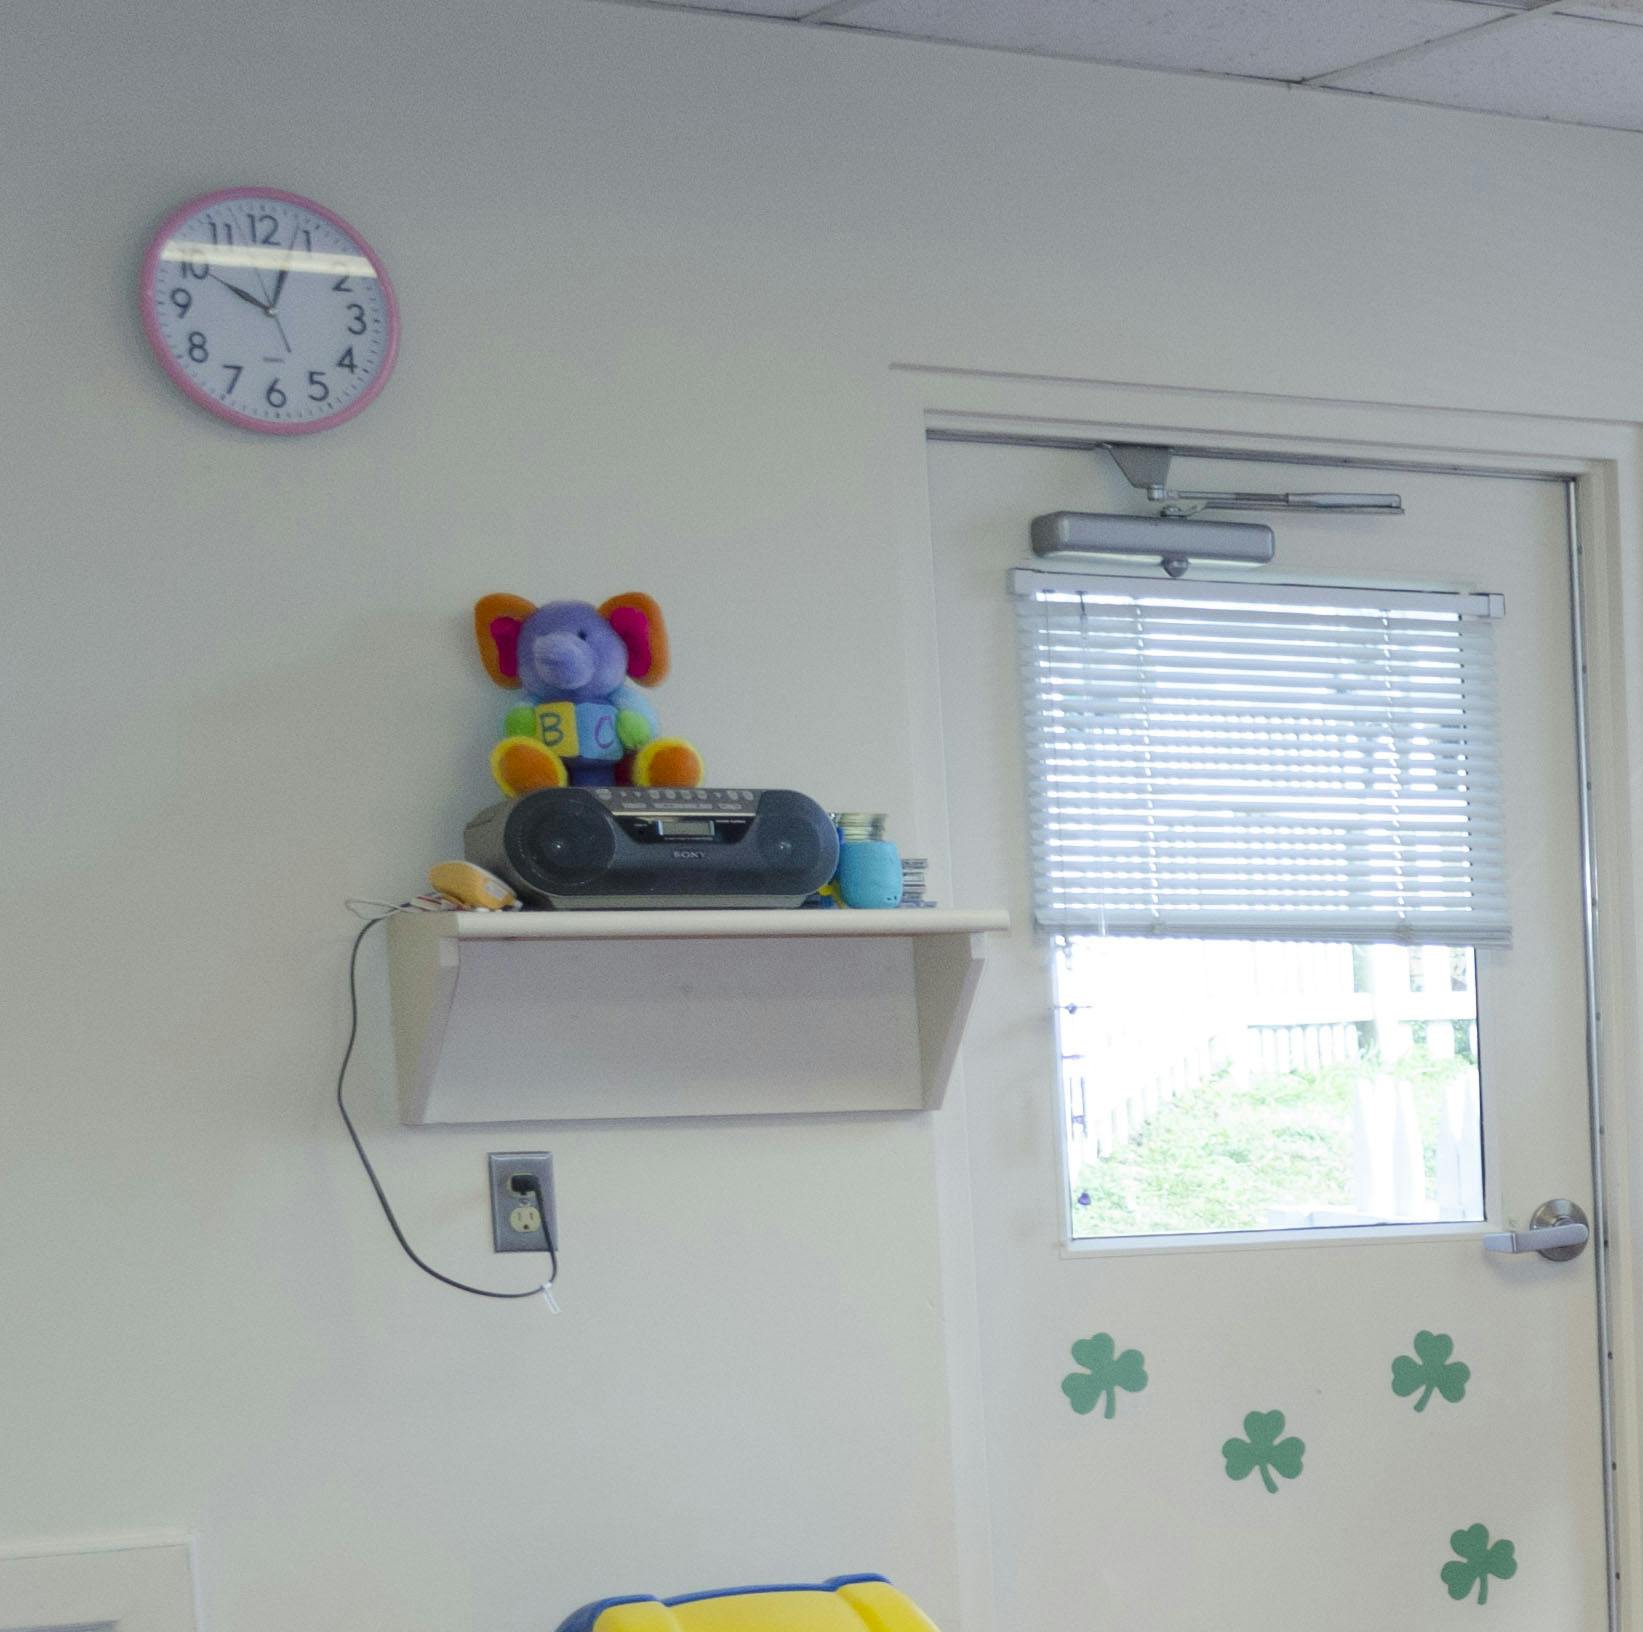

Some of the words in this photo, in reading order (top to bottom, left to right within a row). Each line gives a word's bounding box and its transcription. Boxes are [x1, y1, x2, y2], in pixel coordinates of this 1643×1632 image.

[207, 221, 233, 248] 11
[247, 213, 281, 246] 12
[302, 229, 312, 253] 1
[170, 287, 193, 319] 9
[346, 303, 368, 336] 3
[188, 331, 209, 364] 8
[336, 346, 358, 375] 4
[222, 364, 244, 395] 7
[266, 377, 287, 409] 6
[308, 370, 330, 402] 5
[539, 712, 564, 747] B
[594, 715, 615, 749] C
[673, 851, 706, 860] SONY
